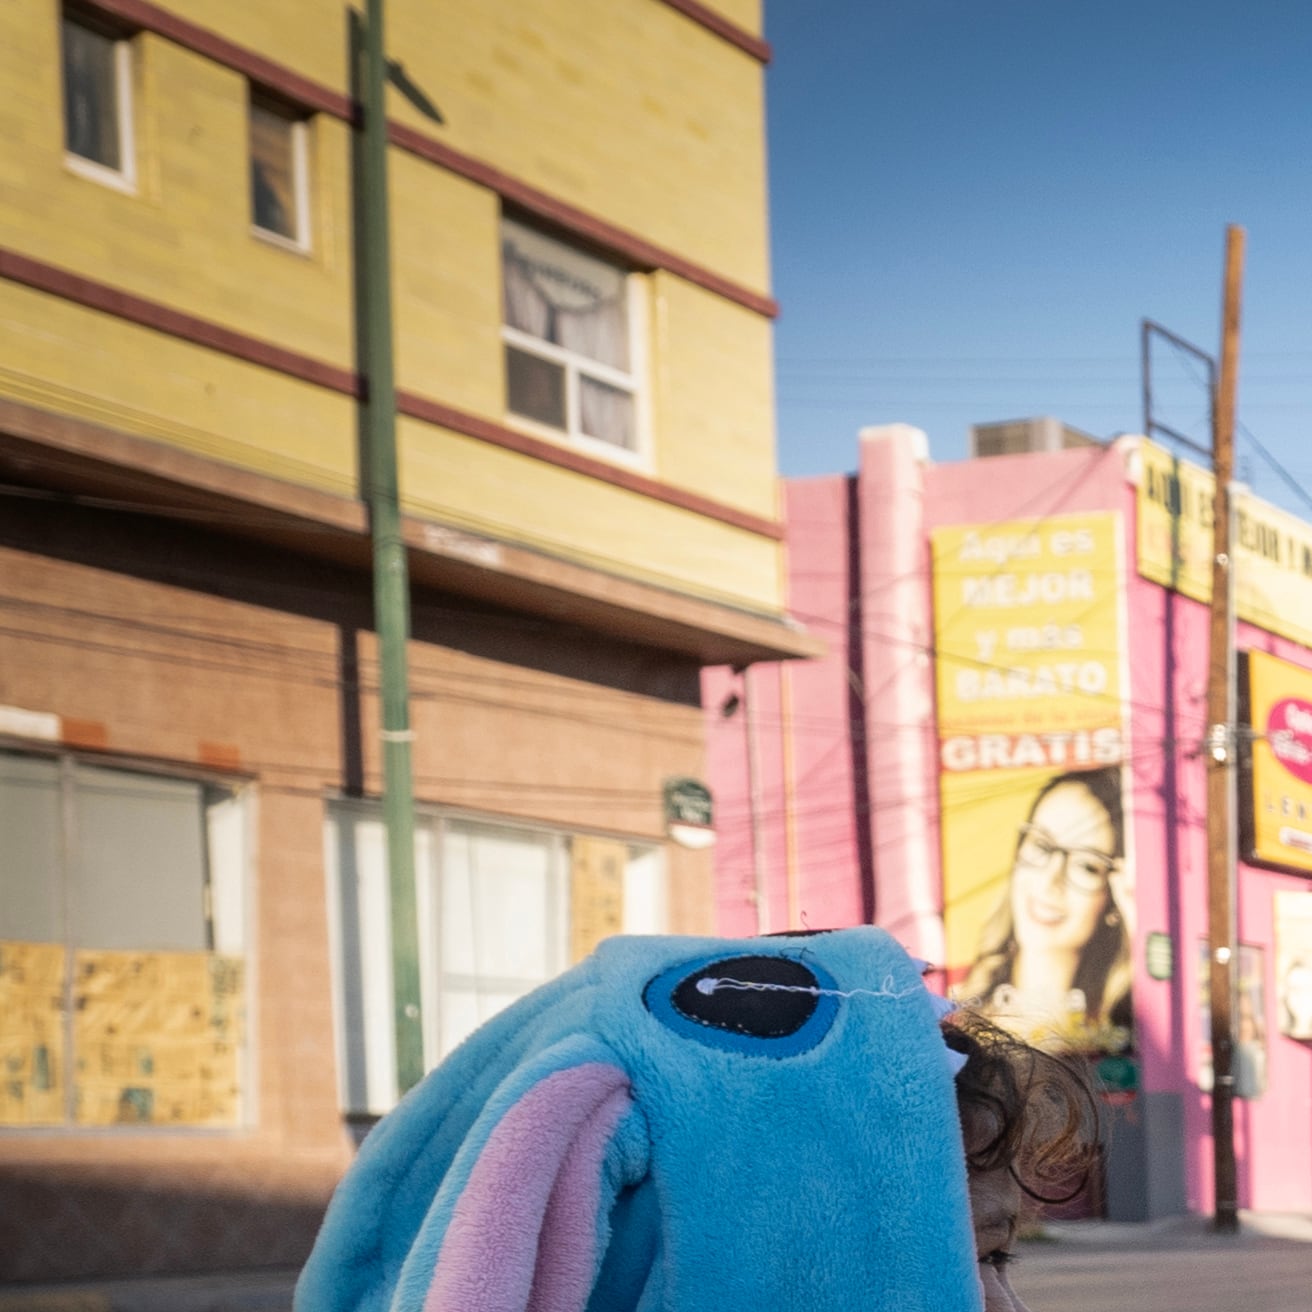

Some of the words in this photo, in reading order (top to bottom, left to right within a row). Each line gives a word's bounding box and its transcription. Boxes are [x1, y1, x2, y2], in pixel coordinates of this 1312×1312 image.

[962, 568, 1094, 609] MEJOR
[956, 661, 1107, 704] BARATO
[941, 727, 1122, 772] GRATIS
